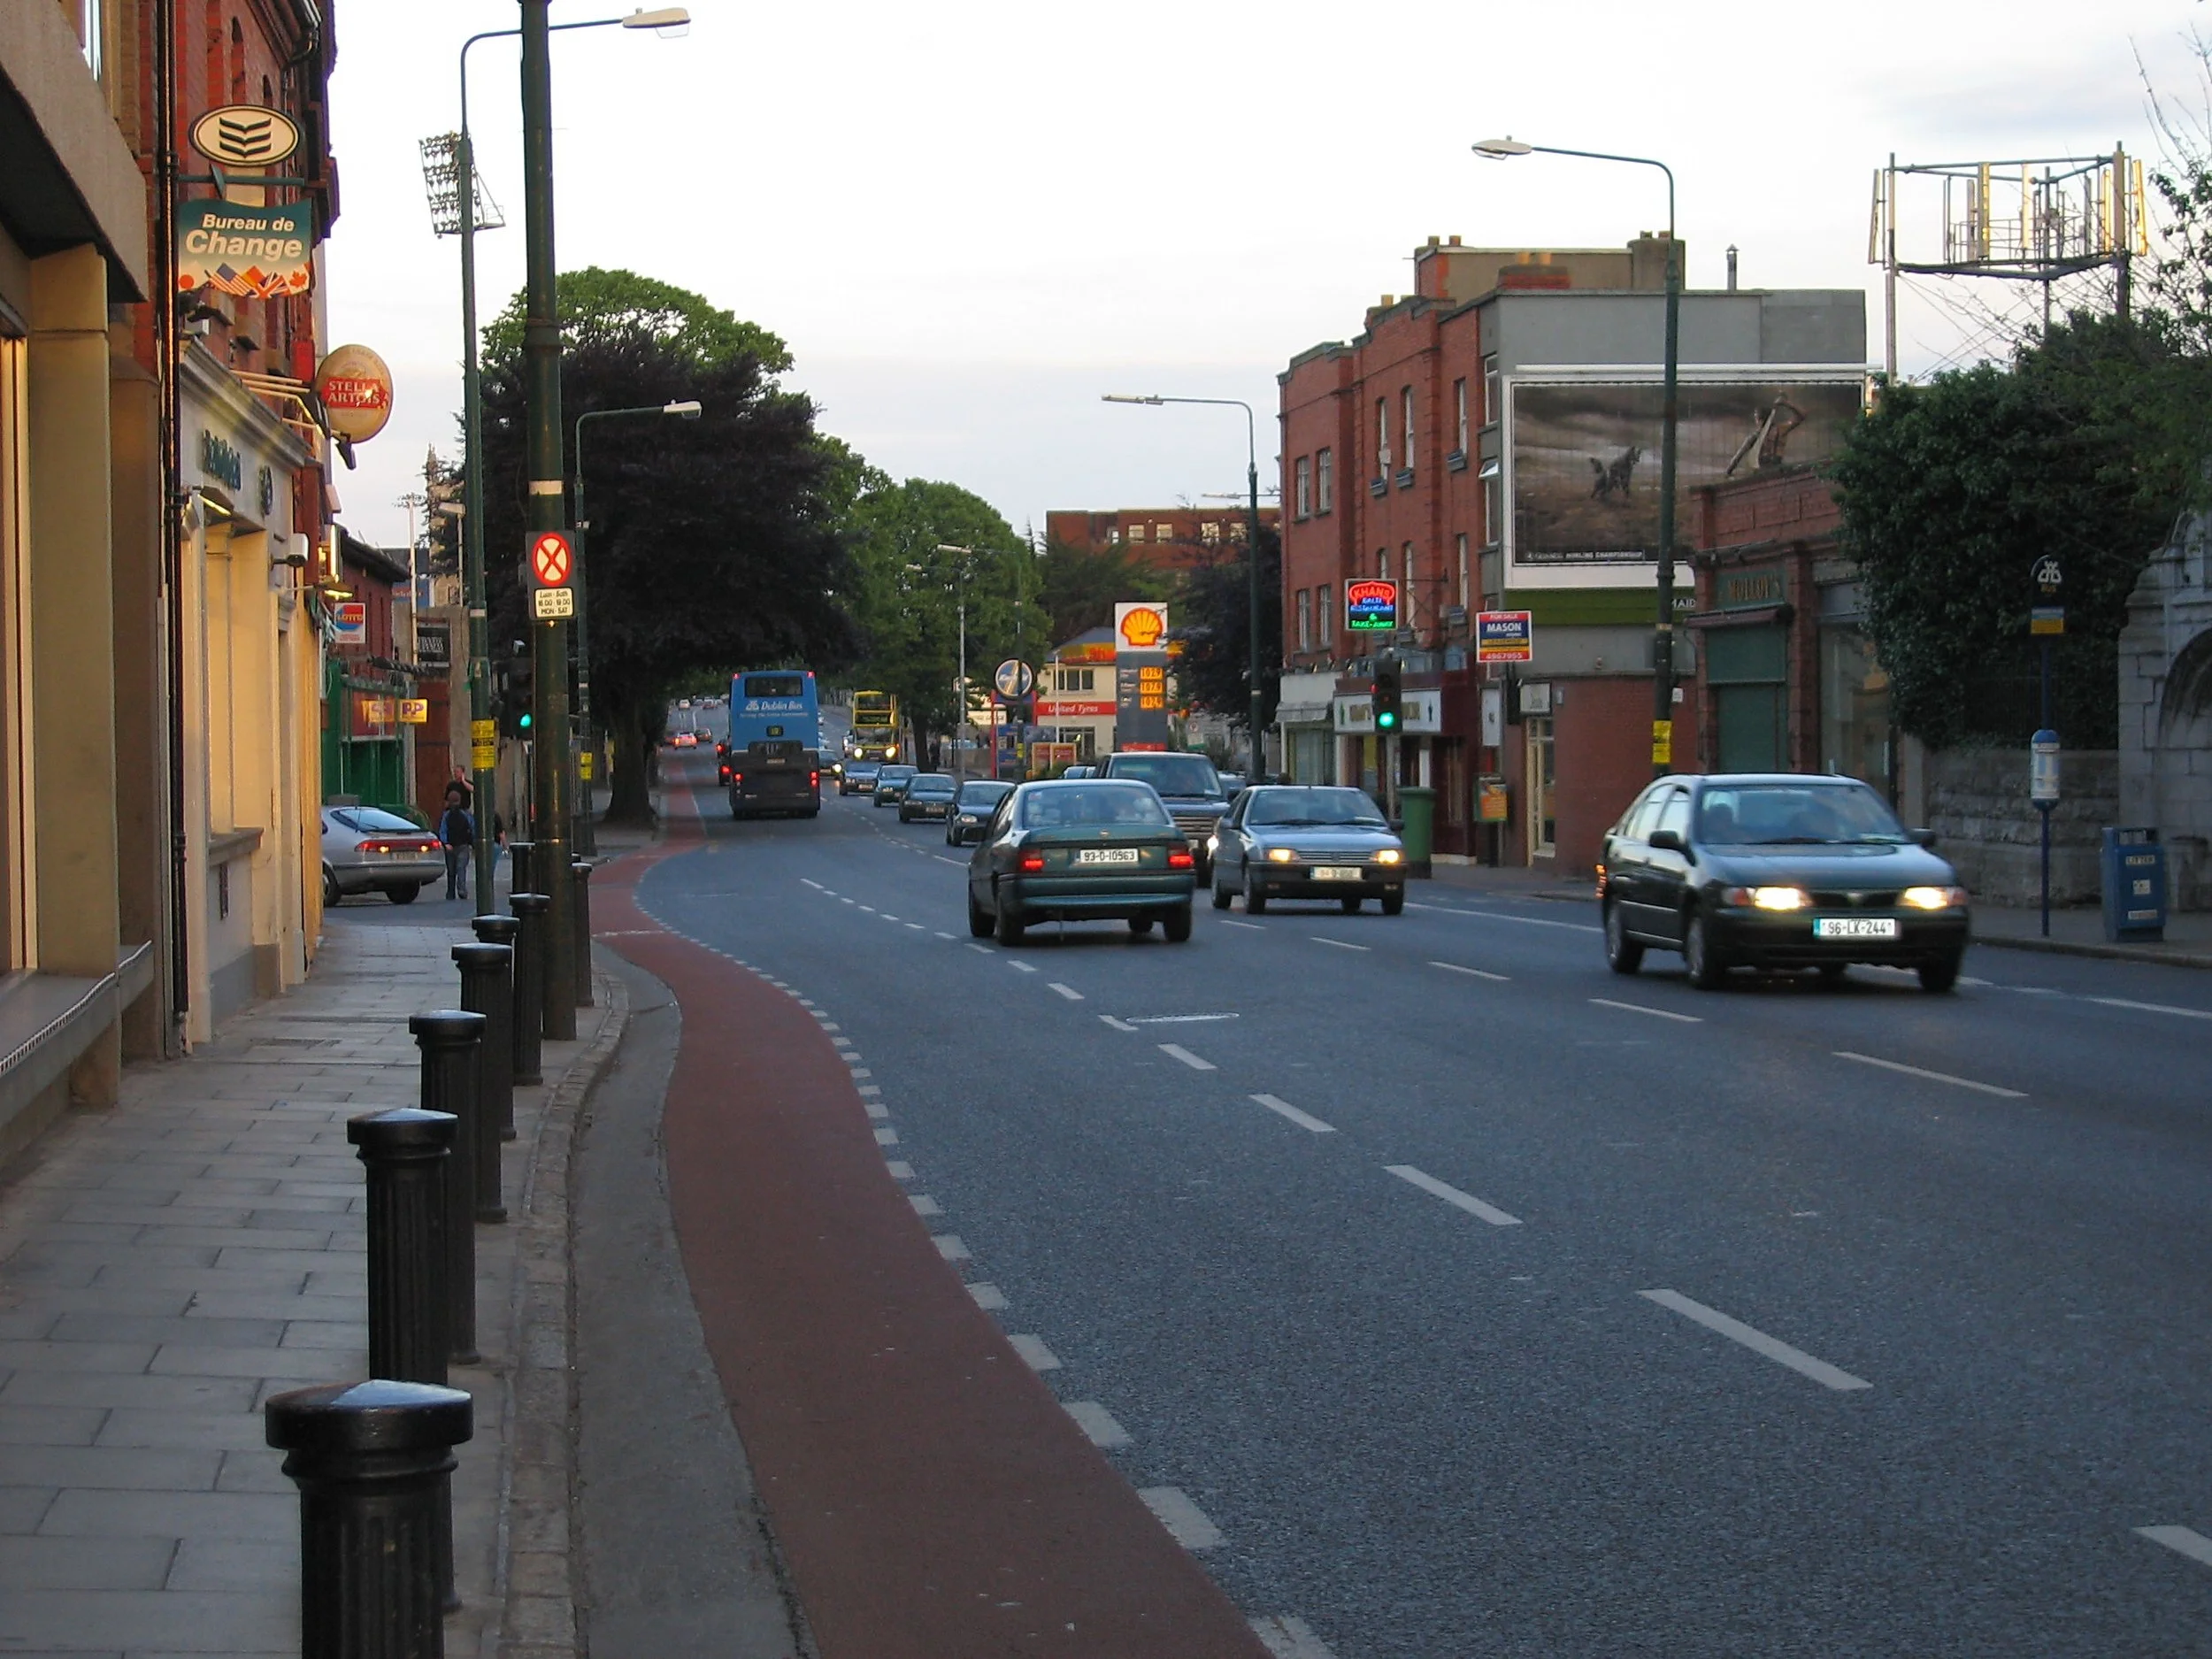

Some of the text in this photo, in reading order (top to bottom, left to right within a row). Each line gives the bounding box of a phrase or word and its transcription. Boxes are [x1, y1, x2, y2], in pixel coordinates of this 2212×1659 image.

[203, 213, 295, 231] Bureau de
[186, 229, 303, 262] Change
[328, 380, 380, 392] STELLA
[328, 392, 380, 403] ARTOIS
[1486, 622, 1523, 632] MASON
[761, 701, 803, 710] Dublin Bus
[1078, 704, 1099, 714] Tyres
[1828, 921, 1886, 935] 96-LK-244
